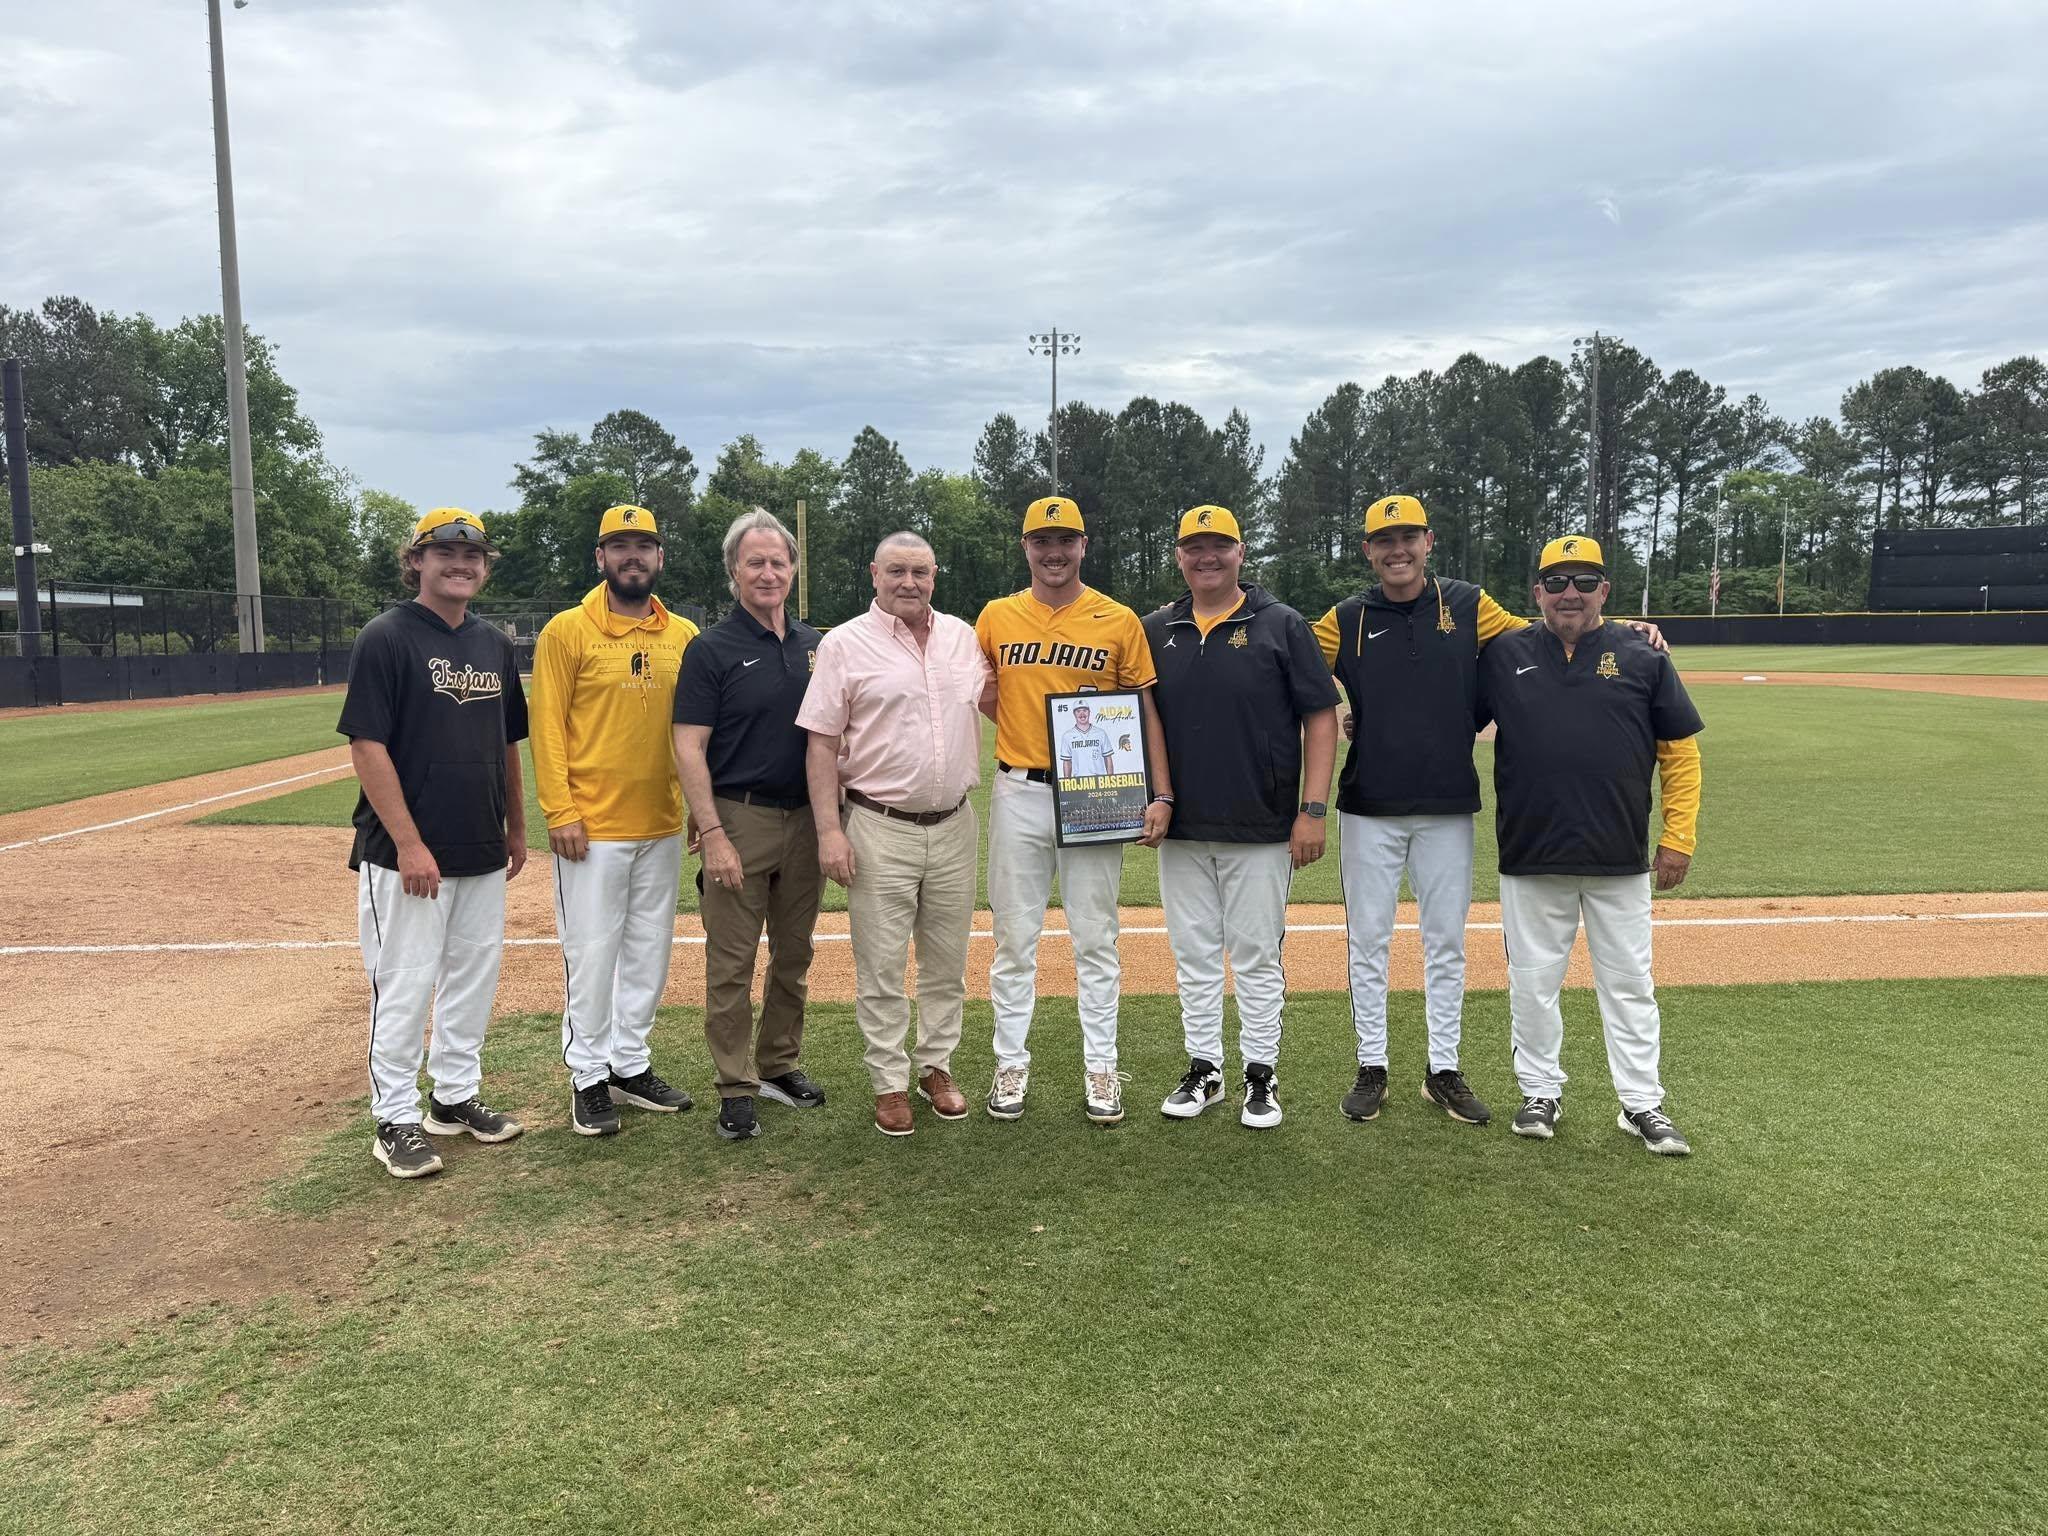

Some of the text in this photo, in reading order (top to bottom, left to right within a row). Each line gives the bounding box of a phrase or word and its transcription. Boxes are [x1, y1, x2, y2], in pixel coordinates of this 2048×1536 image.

[999, 642, 1109, 671] TROJANS
[428, 658, 502, 699] Trojans
[1057, 704, 1069, 712] #5
[1071, 739, 1100, 750] TROJANS
[1060, 774, 1144, 791] TROJAN BASEBALL
[1087, 790, 1119, 798] 2024-2025
